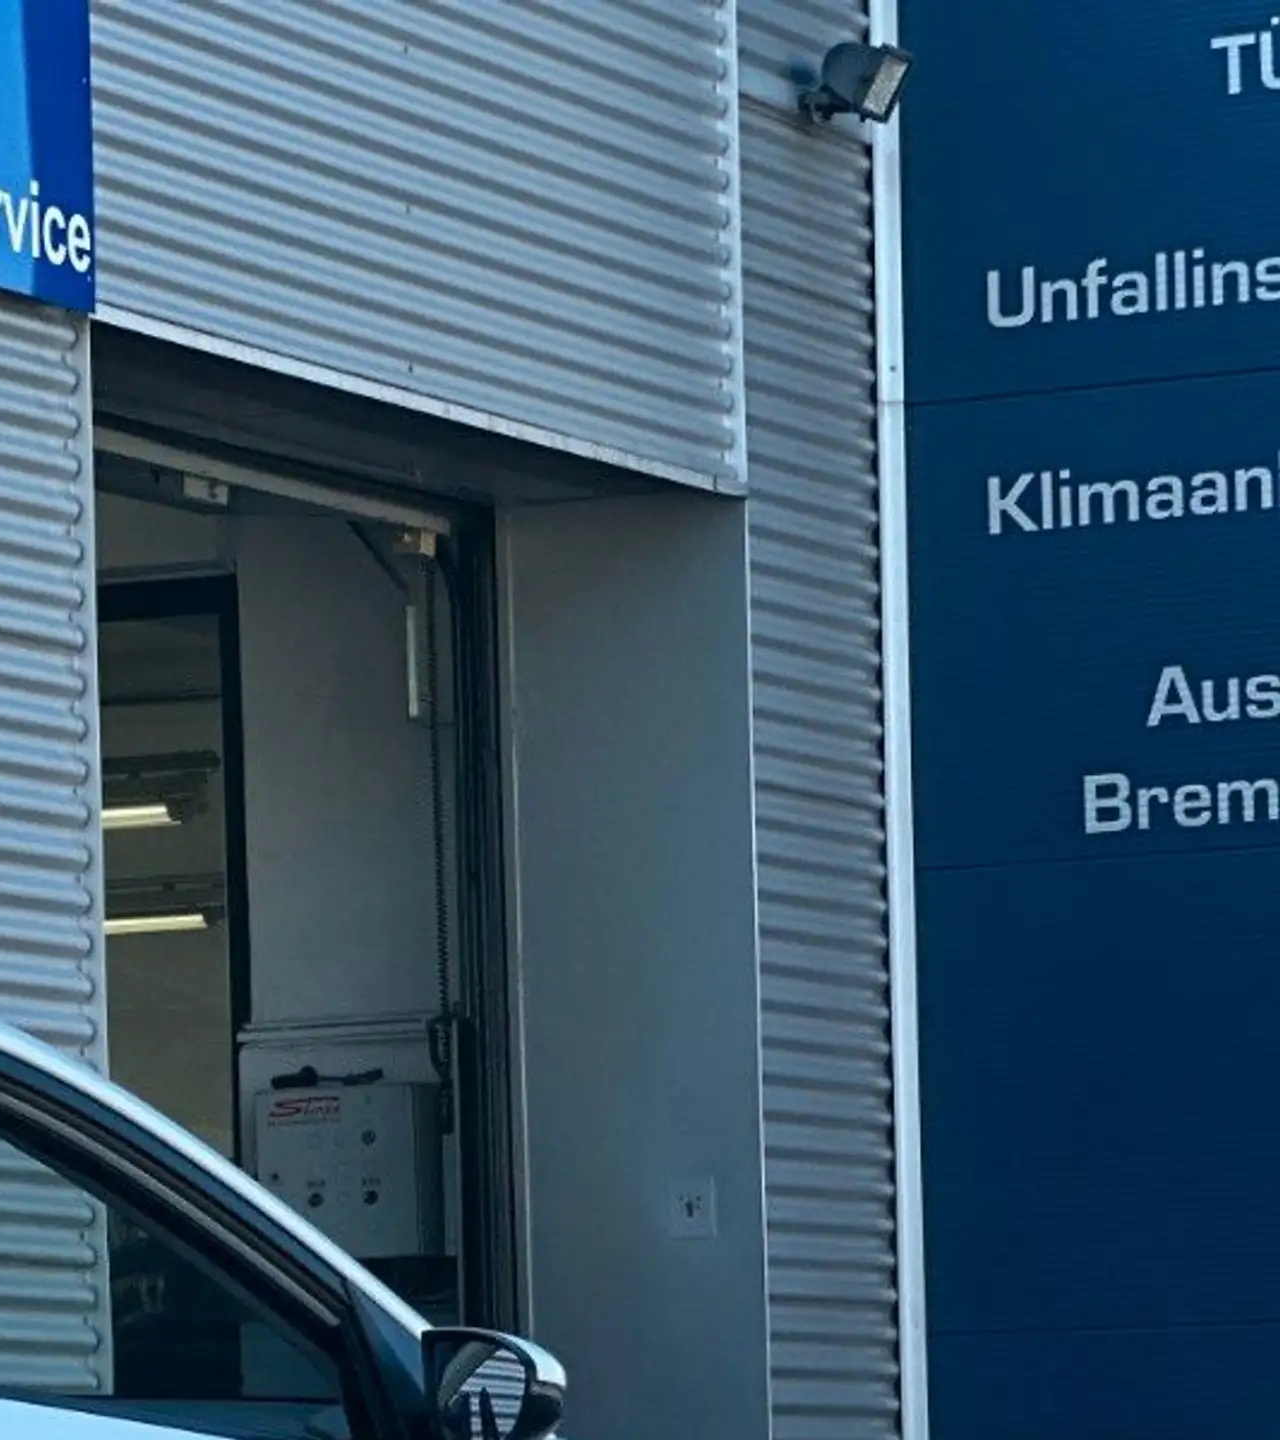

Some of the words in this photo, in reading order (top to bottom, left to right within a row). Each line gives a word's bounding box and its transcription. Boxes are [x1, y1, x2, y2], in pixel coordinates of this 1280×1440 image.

[986, 248, 1280, 328] Unfallins
[986, 450, 1280, 536] Klimaan
[1146, 665, 1280, 728] Aus
[1083, 772, 1280, 835] Brem
